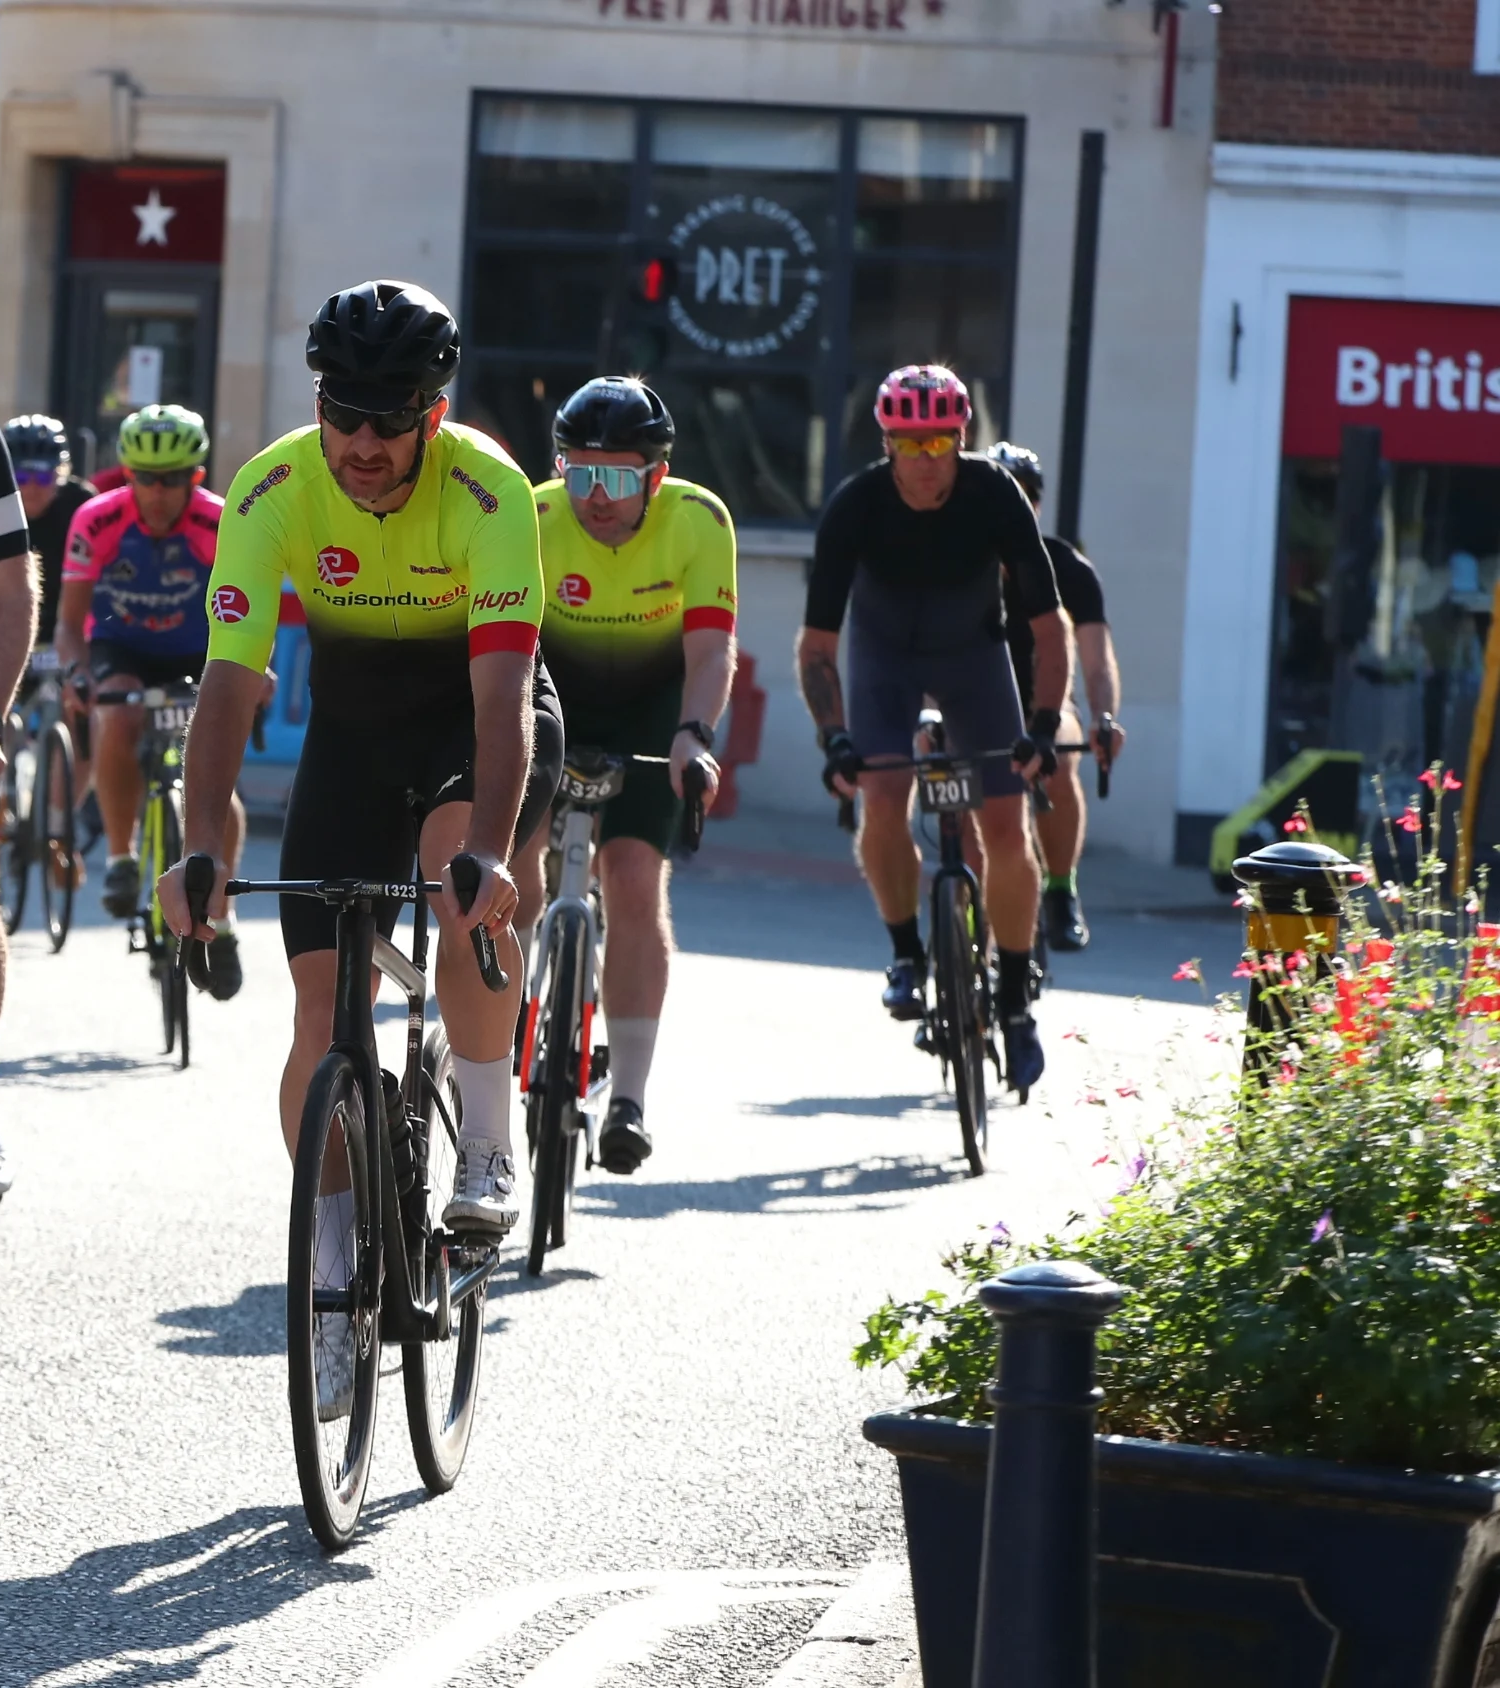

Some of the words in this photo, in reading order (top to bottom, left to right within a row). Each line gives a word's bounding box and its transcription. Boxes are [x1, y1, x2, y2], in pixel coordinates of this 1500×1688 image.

[696, 247, 789, 306] PRET
[238, 464, 291, 516] IN-GEAR
[450, 466, 498, 514] IN-GEAR
[471, 586, 529, 615] Hup!
[154, 707, 196, 730] 131
[561, 773, 612, 799] 1326
[927, 779, 969, 805] 1201
[384, 884, 417, 899] 1323
